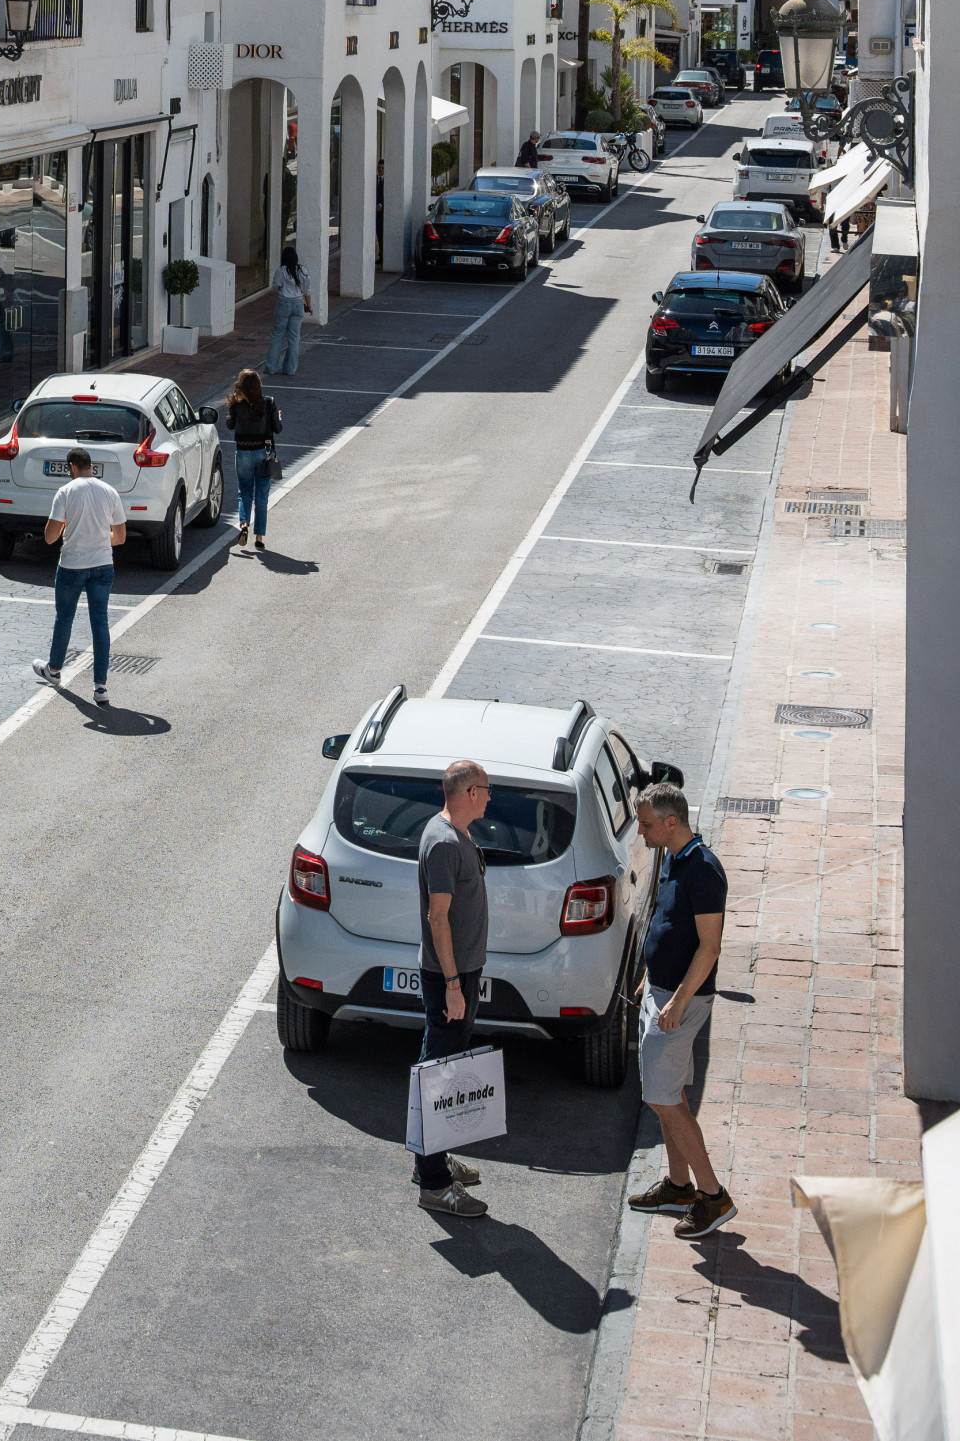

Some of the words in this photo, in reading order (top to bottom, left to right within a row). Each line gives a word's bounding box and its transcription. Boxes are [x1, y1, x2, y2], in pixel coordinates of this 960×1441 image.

[236, 43, 283, 60] DIOR
[697, 346, 715, 354] 3194
[717, 347, 732, 355] KGH
[50, 463, 70, 473] 638
[338, 875, 383, 888] SANDERO
[397, 971, 420, 991] 06
[433, 1095, 453, 1112] viva
[456, 1091, 466, 1106] la
[468, 1083, 495, 1102] moda
